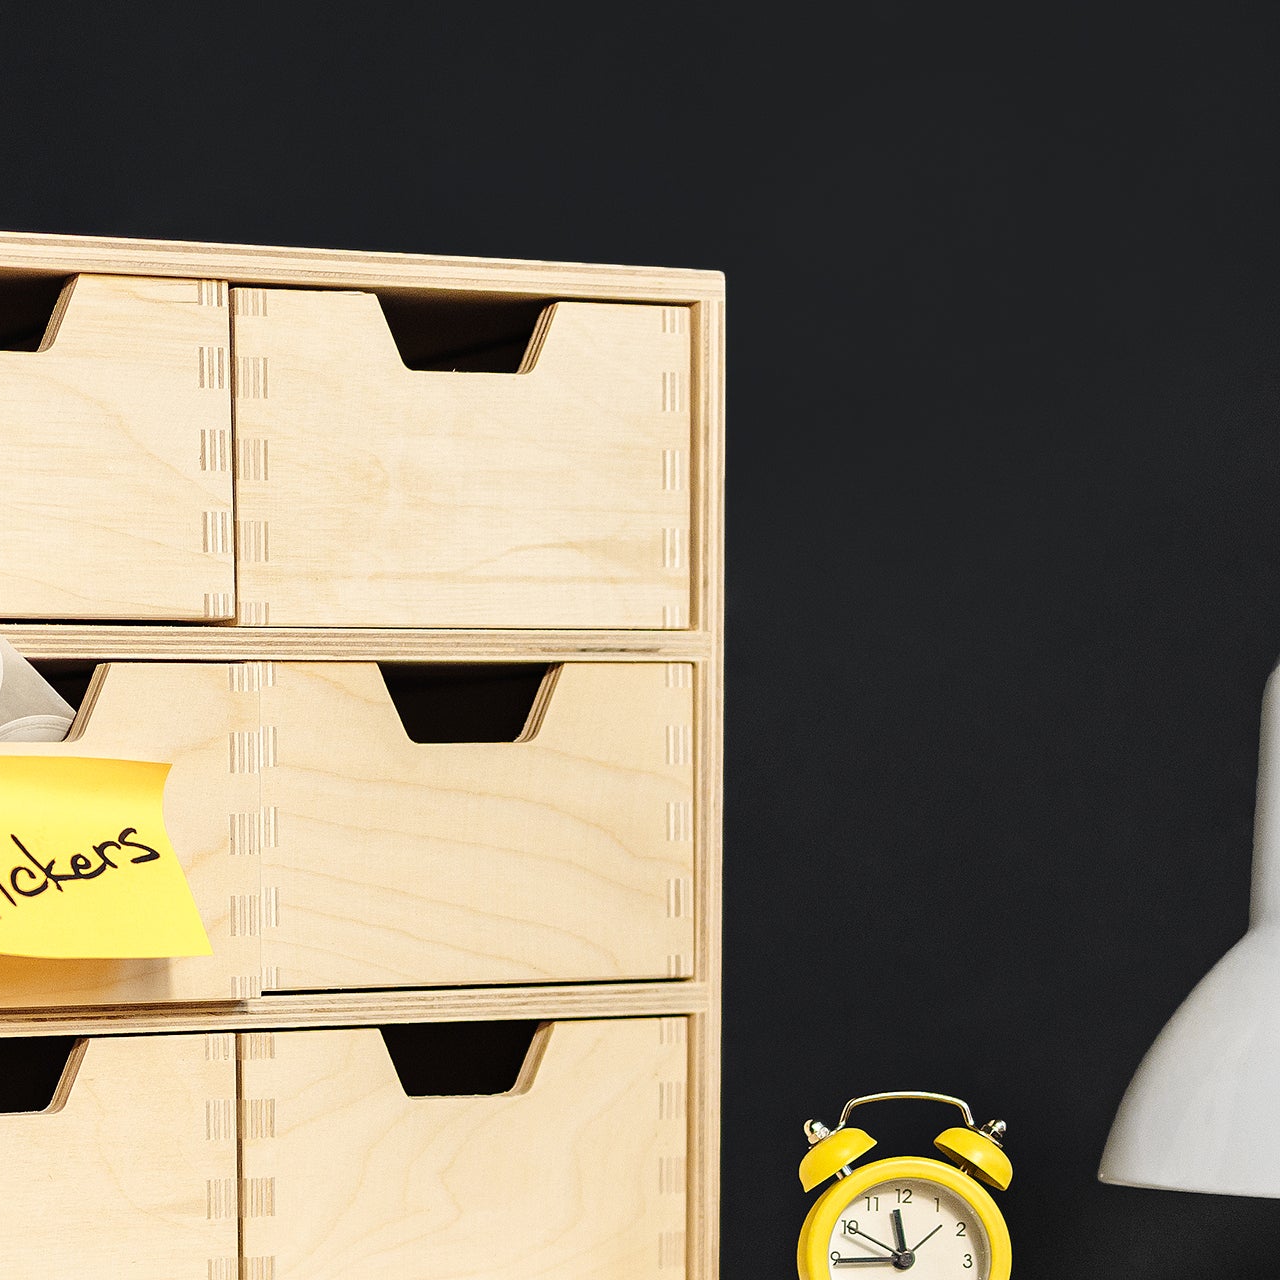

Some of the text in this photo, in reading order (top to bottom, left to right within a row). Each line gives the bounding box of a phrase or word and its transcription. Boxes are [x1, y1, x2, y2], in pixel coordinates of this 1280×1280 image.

[864, 1196, 880, 1212] 11
[894, 1188, 913, 1204] 12
[933, 1197, 941, 1213] 1
[841, 1219, 859, 1235] 10
[955, 1222, 966, 1237] 2
[830, 1251, 841, 1266] 9
[962, 1253, 974, 1269] 3
